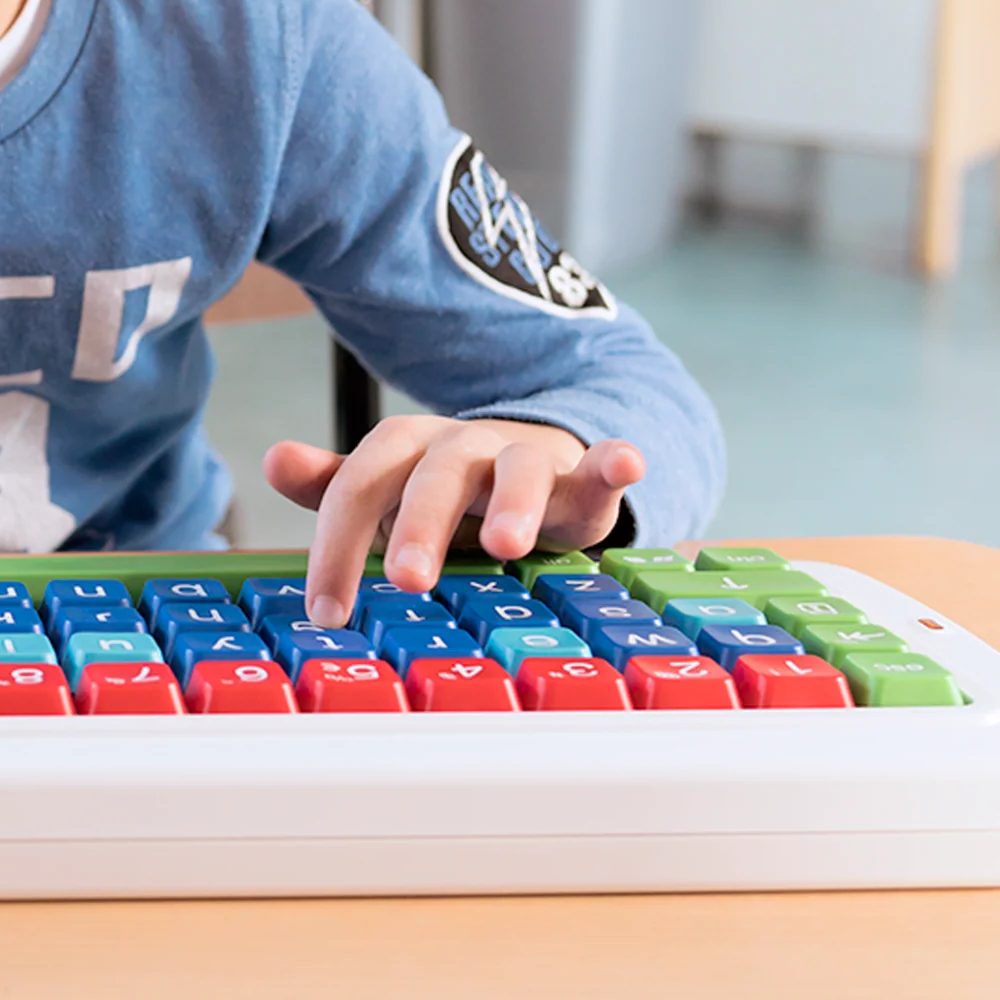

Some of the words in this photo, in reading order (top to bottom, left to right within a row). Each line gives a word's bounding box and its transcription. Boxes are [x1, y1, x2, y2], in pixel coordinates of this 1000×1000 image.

[470, 581, 503, 592] x
[565, 580, 600, 592] z
[212, 636, 244, 650] y
[427, 636, 449, 649] r
[627, 633, 678, 646] w
[731, 629, 776, 645] q
[99, 639, 134, 651] u
